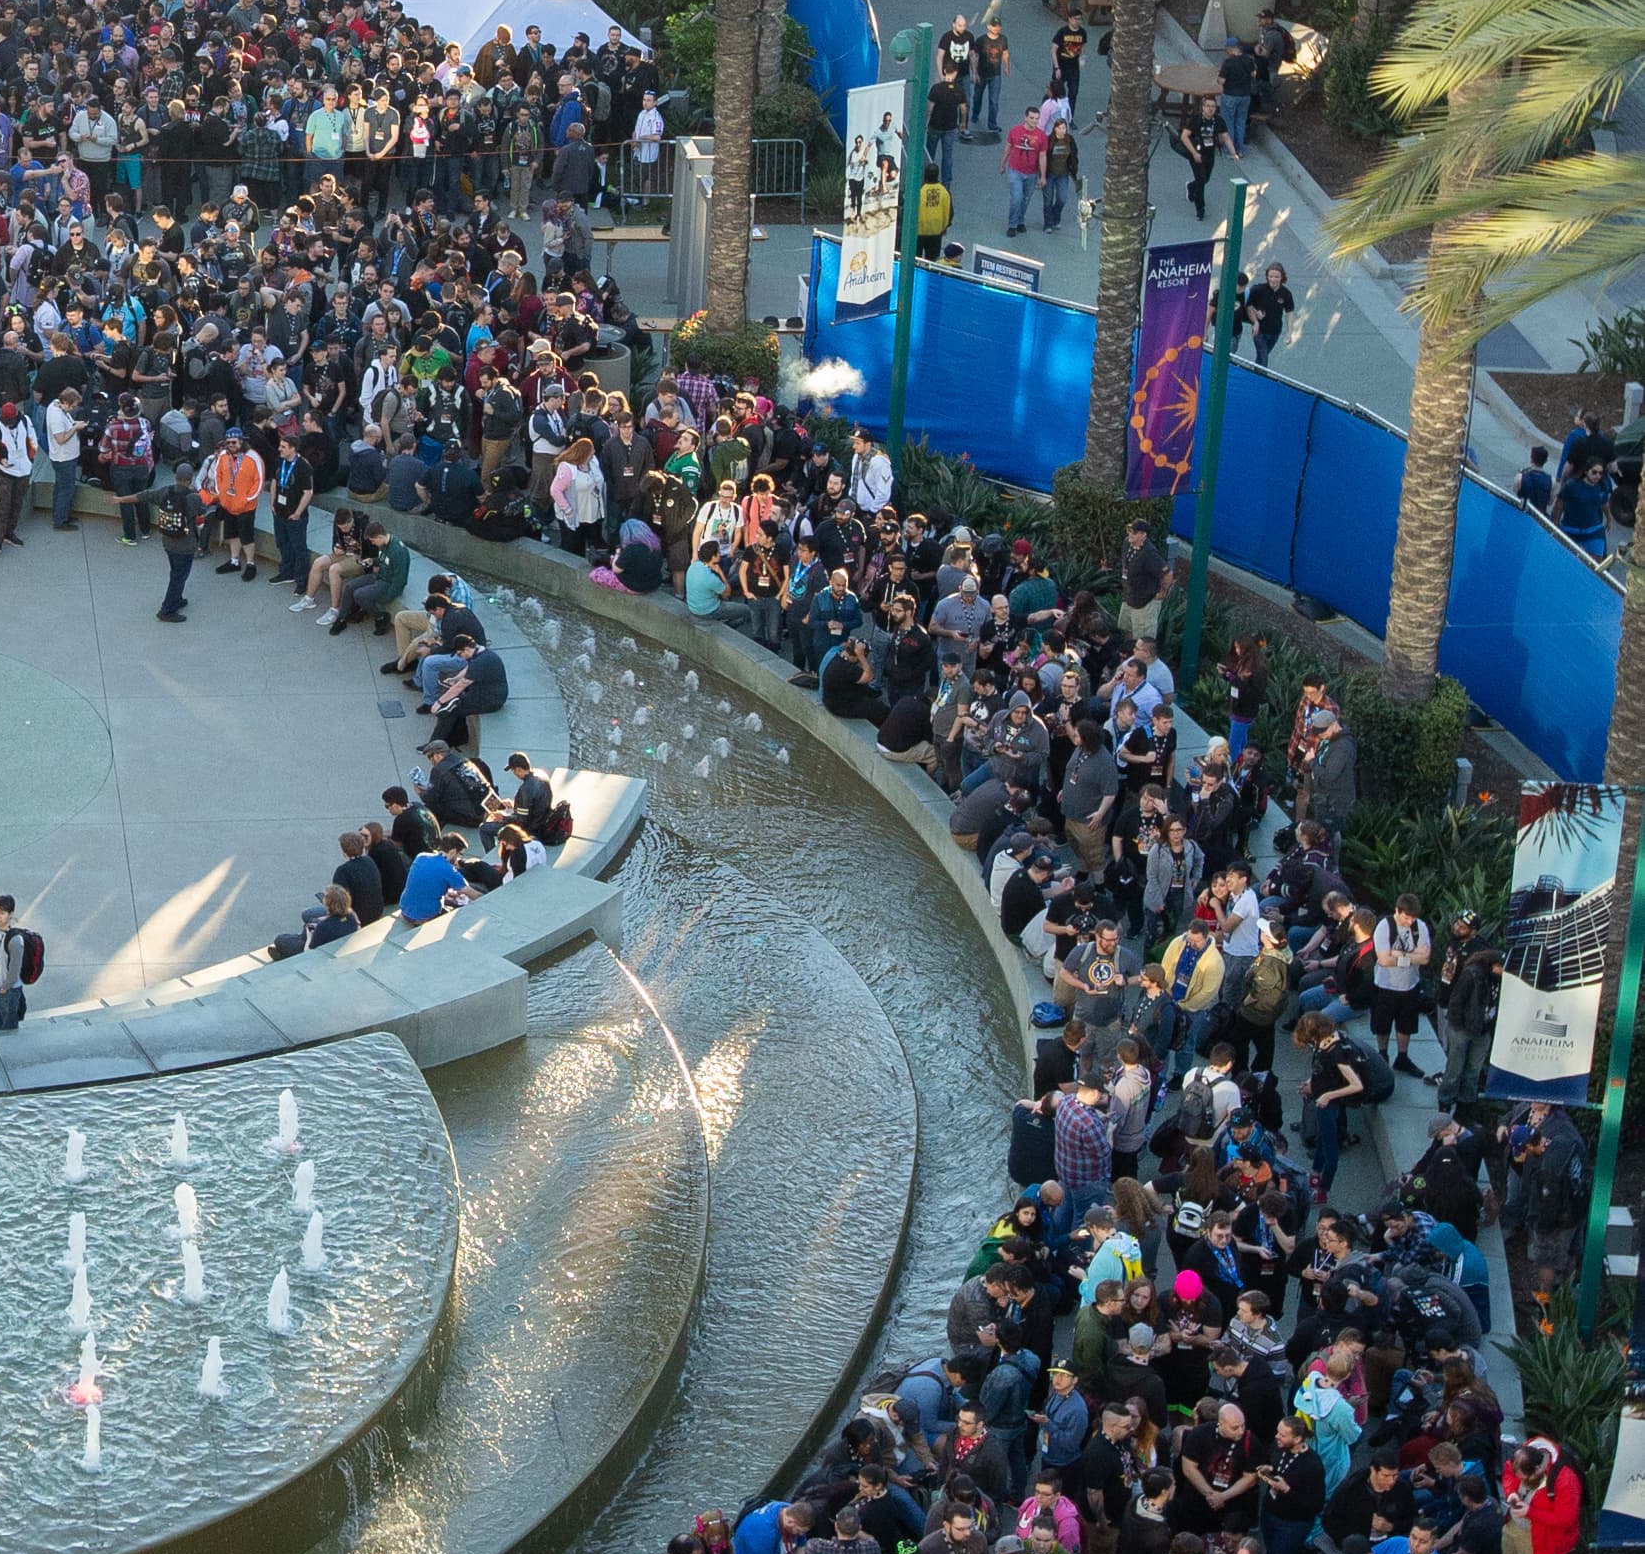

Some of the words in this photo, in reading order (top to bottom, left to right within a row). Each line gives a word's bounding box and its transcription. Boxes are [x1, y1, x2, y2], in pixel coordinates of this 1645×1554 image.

[1159, 257, 1175, 267] THE
[843, 265, 887, 291] Anaheim
[981, 258, 996, 272] ITEM
[995, 262, 1035, 283] RESTRICTIONS
[1147, 262, 1213, 281] ANAHEIM
[1157, 277, 1190, 289] RESORT
[1511, 1037, 1575, 1049] ANAHEIM
